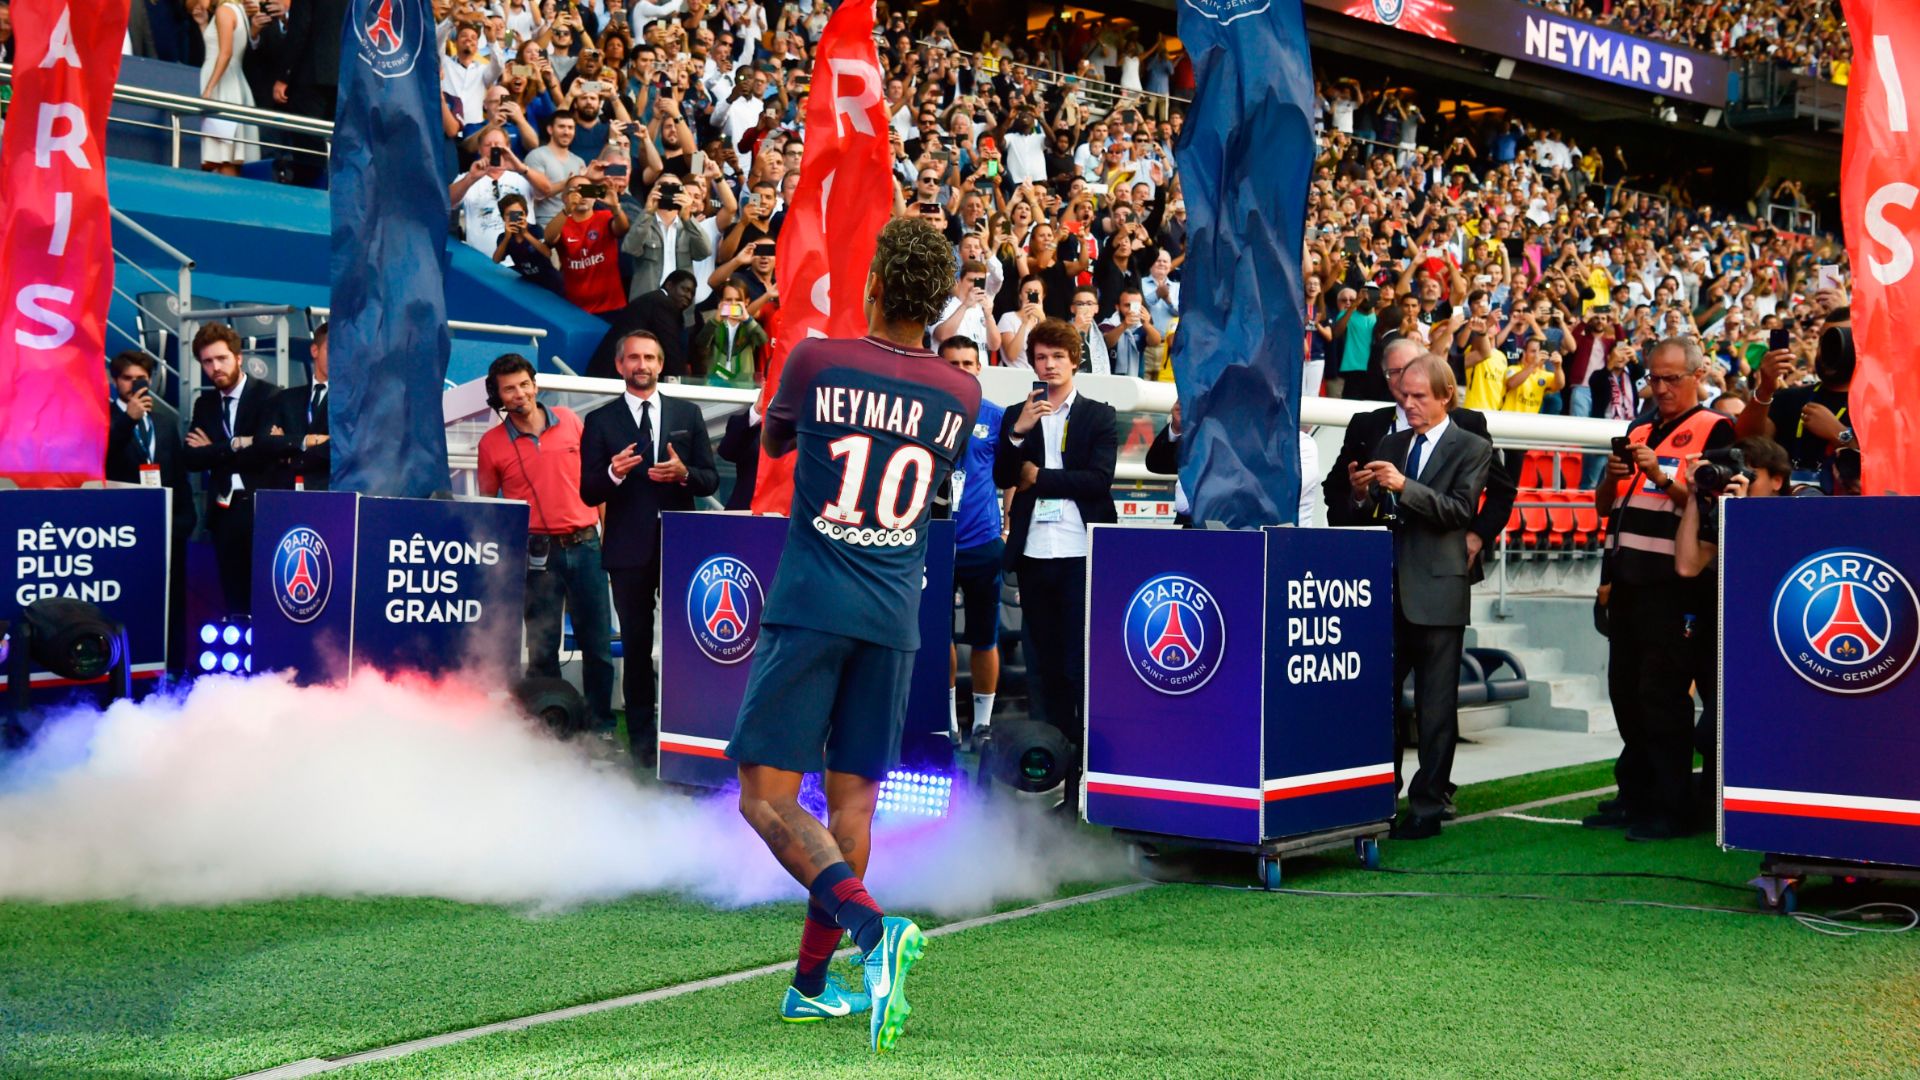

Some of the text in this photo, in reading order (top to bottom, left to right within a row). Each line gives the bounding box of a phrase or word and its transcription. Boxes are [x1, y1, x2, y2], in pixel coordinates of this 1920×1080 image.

[1525, 15, 1693, 94] NEYMAR JR
[815, 386, 964, 450] NEYMAR JR
[821, 433, 936, 530] 10
[17, 521, 137, 552] RÊVONS
[283, 532, 323, 556] PARIS
[814, 518, 915, 545] ooredoo
[388, 532, 500, 565] RÊVONS
[17, 554, 94, 579] PLUS
[387, 569, 458, 593] PLUS
[700, 562, 752, 589] PARIS
[1797, 559, 1896, 593] PARIS
[1141, 582, 1208, 611] PARIS
[1287, 570, 1372, 609] RÊVONS
[385, 599, 483, 623] GRAND
[1287, 615, 1342, 647] PLUS
[1287, 651, 1361, 685] GRAND
